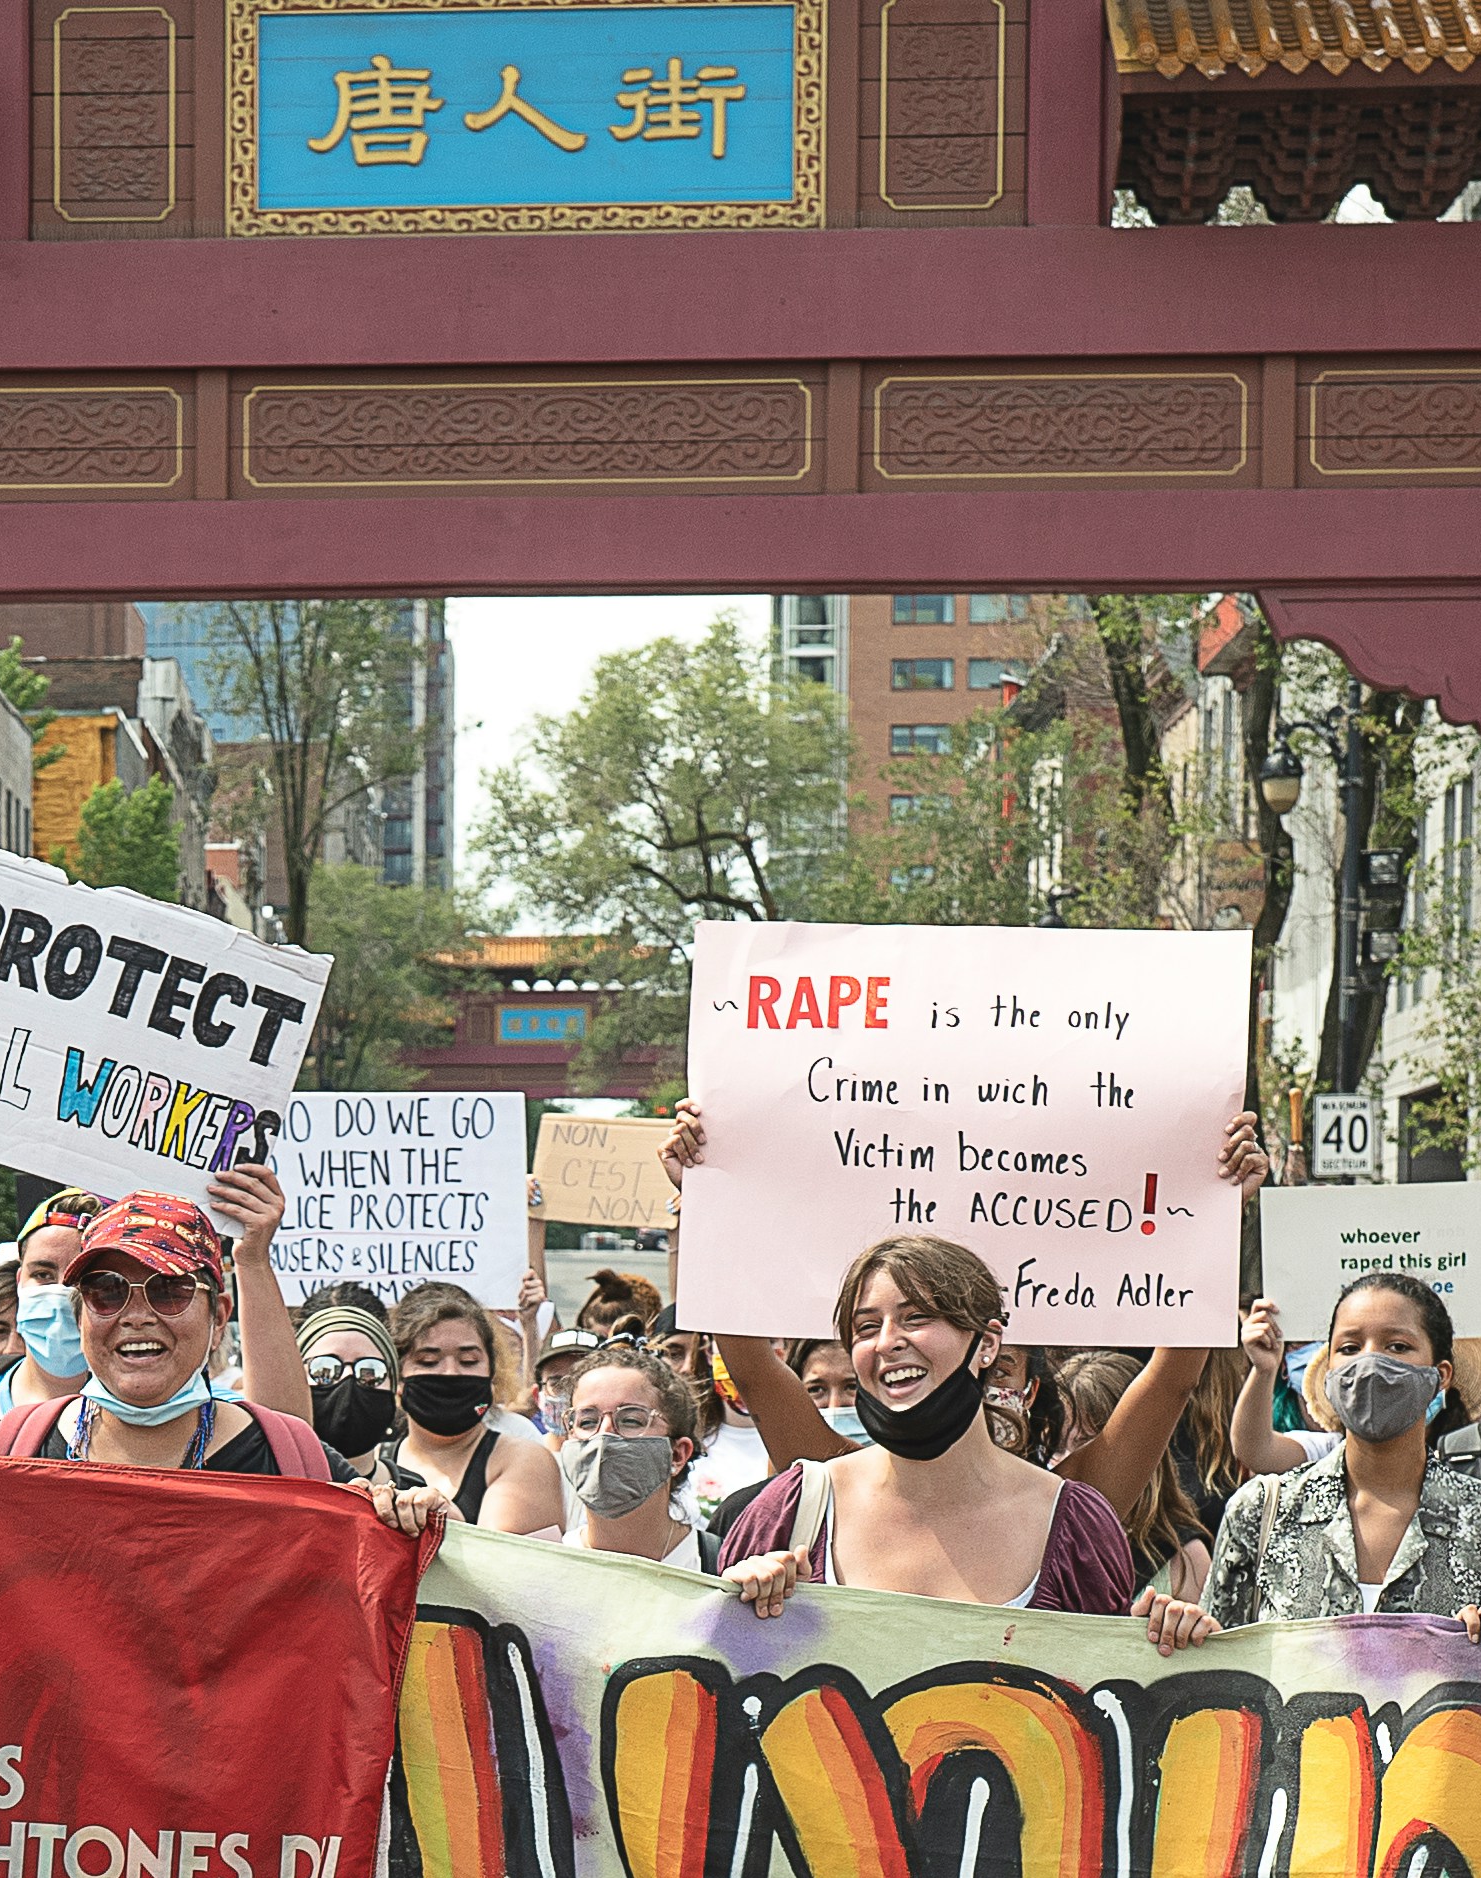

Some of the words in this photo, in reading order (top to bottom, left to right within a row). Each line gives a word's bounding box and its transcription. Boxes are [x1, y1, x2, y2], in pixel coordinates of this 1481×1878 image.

[307, 54, 746, 167] 唐人街
[746, 975, 891, 1030] RAPE
[930, 1001, 961, 1029] is
[990, 994, 1040, 1029] the
[1067, 1000, 1130, 1040] only
[808, 1056, 898, 1105] Crime
[923, 1077, 950, 1103] in
[978, 1073, 1048, 1107] wich
[1089, 1071, 1135, 1110] the
[56, 1046, 283, 1174] WORKERS
[336, 1098, 375, 1137] DO
[387, 1098, 435, 1137] WE
[452, 1098, 495, 1139] GO
[551, 1123, 617, 1153] NON,
[1322, 1114, 1368, 1153] 40
[299, 1150, 390, 1188] WHEN
[400, 1148, 463, 1185] THE
[834, 1129, 934, 1172] Victim
[958, 1130, 1087, 1178] becomes
[560, 1158, 644, 1200] C'EST
[280, 1194, 335, 1230] LICE
[350, 1192, 489, 1231] PROTECTS
[587, 1196, 655, 1224] NON
[890, 1189, 937, 1224] the
[1340, 1228, 1421, 1244] whoever
[352, 1247, 363, 1266] &
[368, 1241, 478, 1274] SILENCES
[1340, 1254, 1393, 1272] raped
[1399, 1253, 1432, 1268] this
[1437, 1252, 1467, 1271] girl
[1116, 1272, 1195, 1308] Adler
